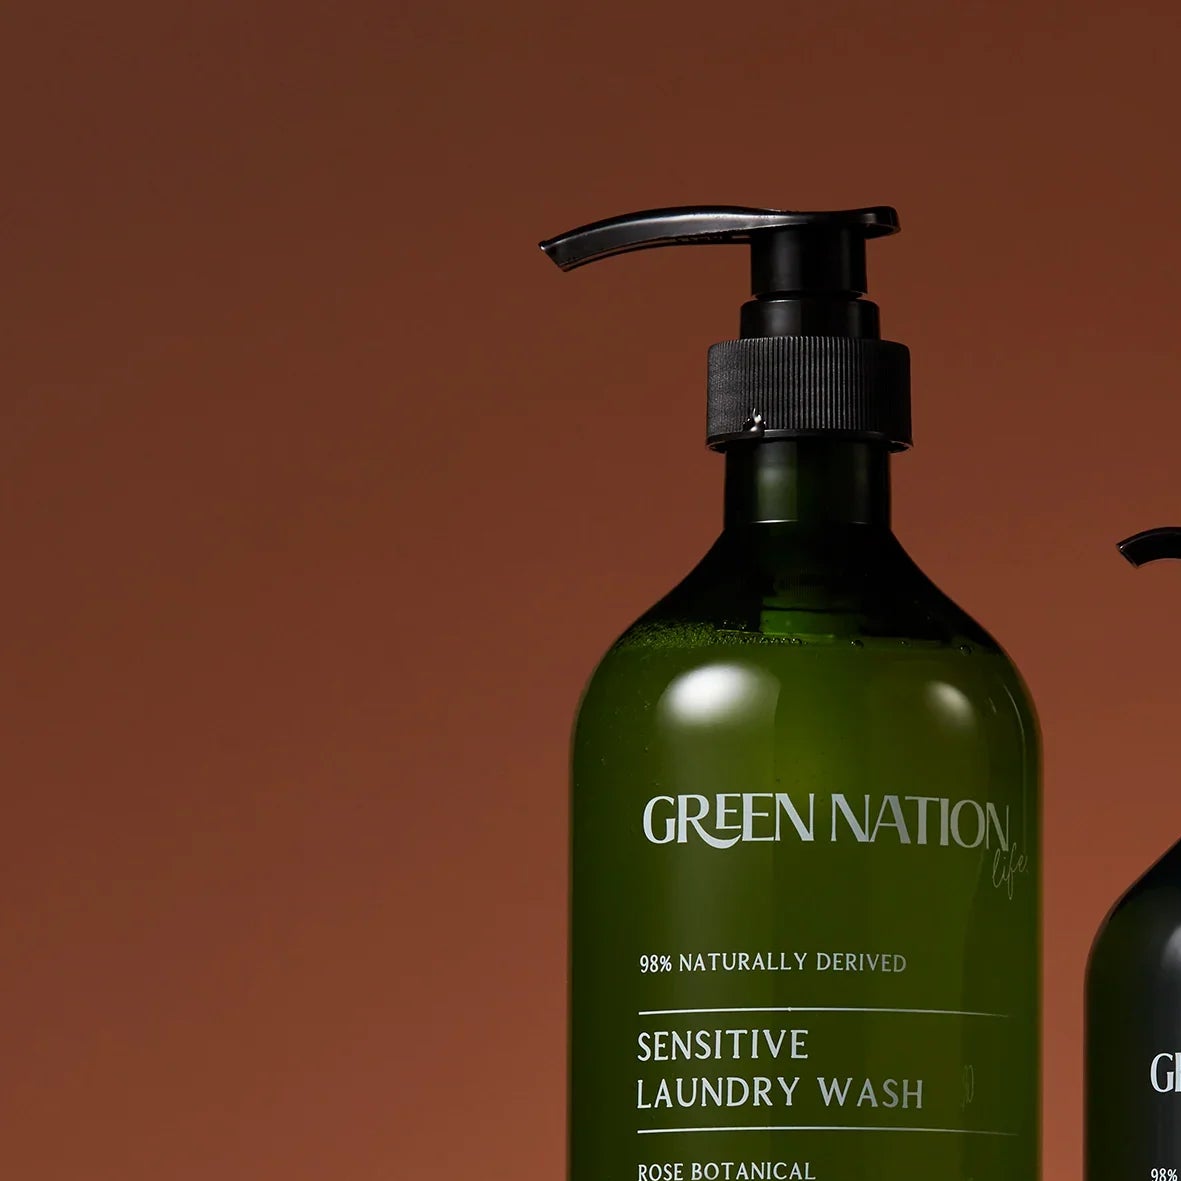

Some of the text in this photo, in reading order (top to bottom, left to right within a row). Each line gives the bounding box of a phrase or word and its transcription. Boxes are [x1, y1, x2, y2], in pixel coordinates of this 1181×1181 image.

[642, 792, 1011, 852] GREEN NATION
[639, 952, 908, 974] 98% NATURALLY DERIVED
[636, 1029, 810, 1062] SENSITIVE
[636, 1076, 801, 1110] LAUNDRY
[816, 1076, 924, 1110] WASH
[690, 1161, 817, 1181] BOTANICAL
